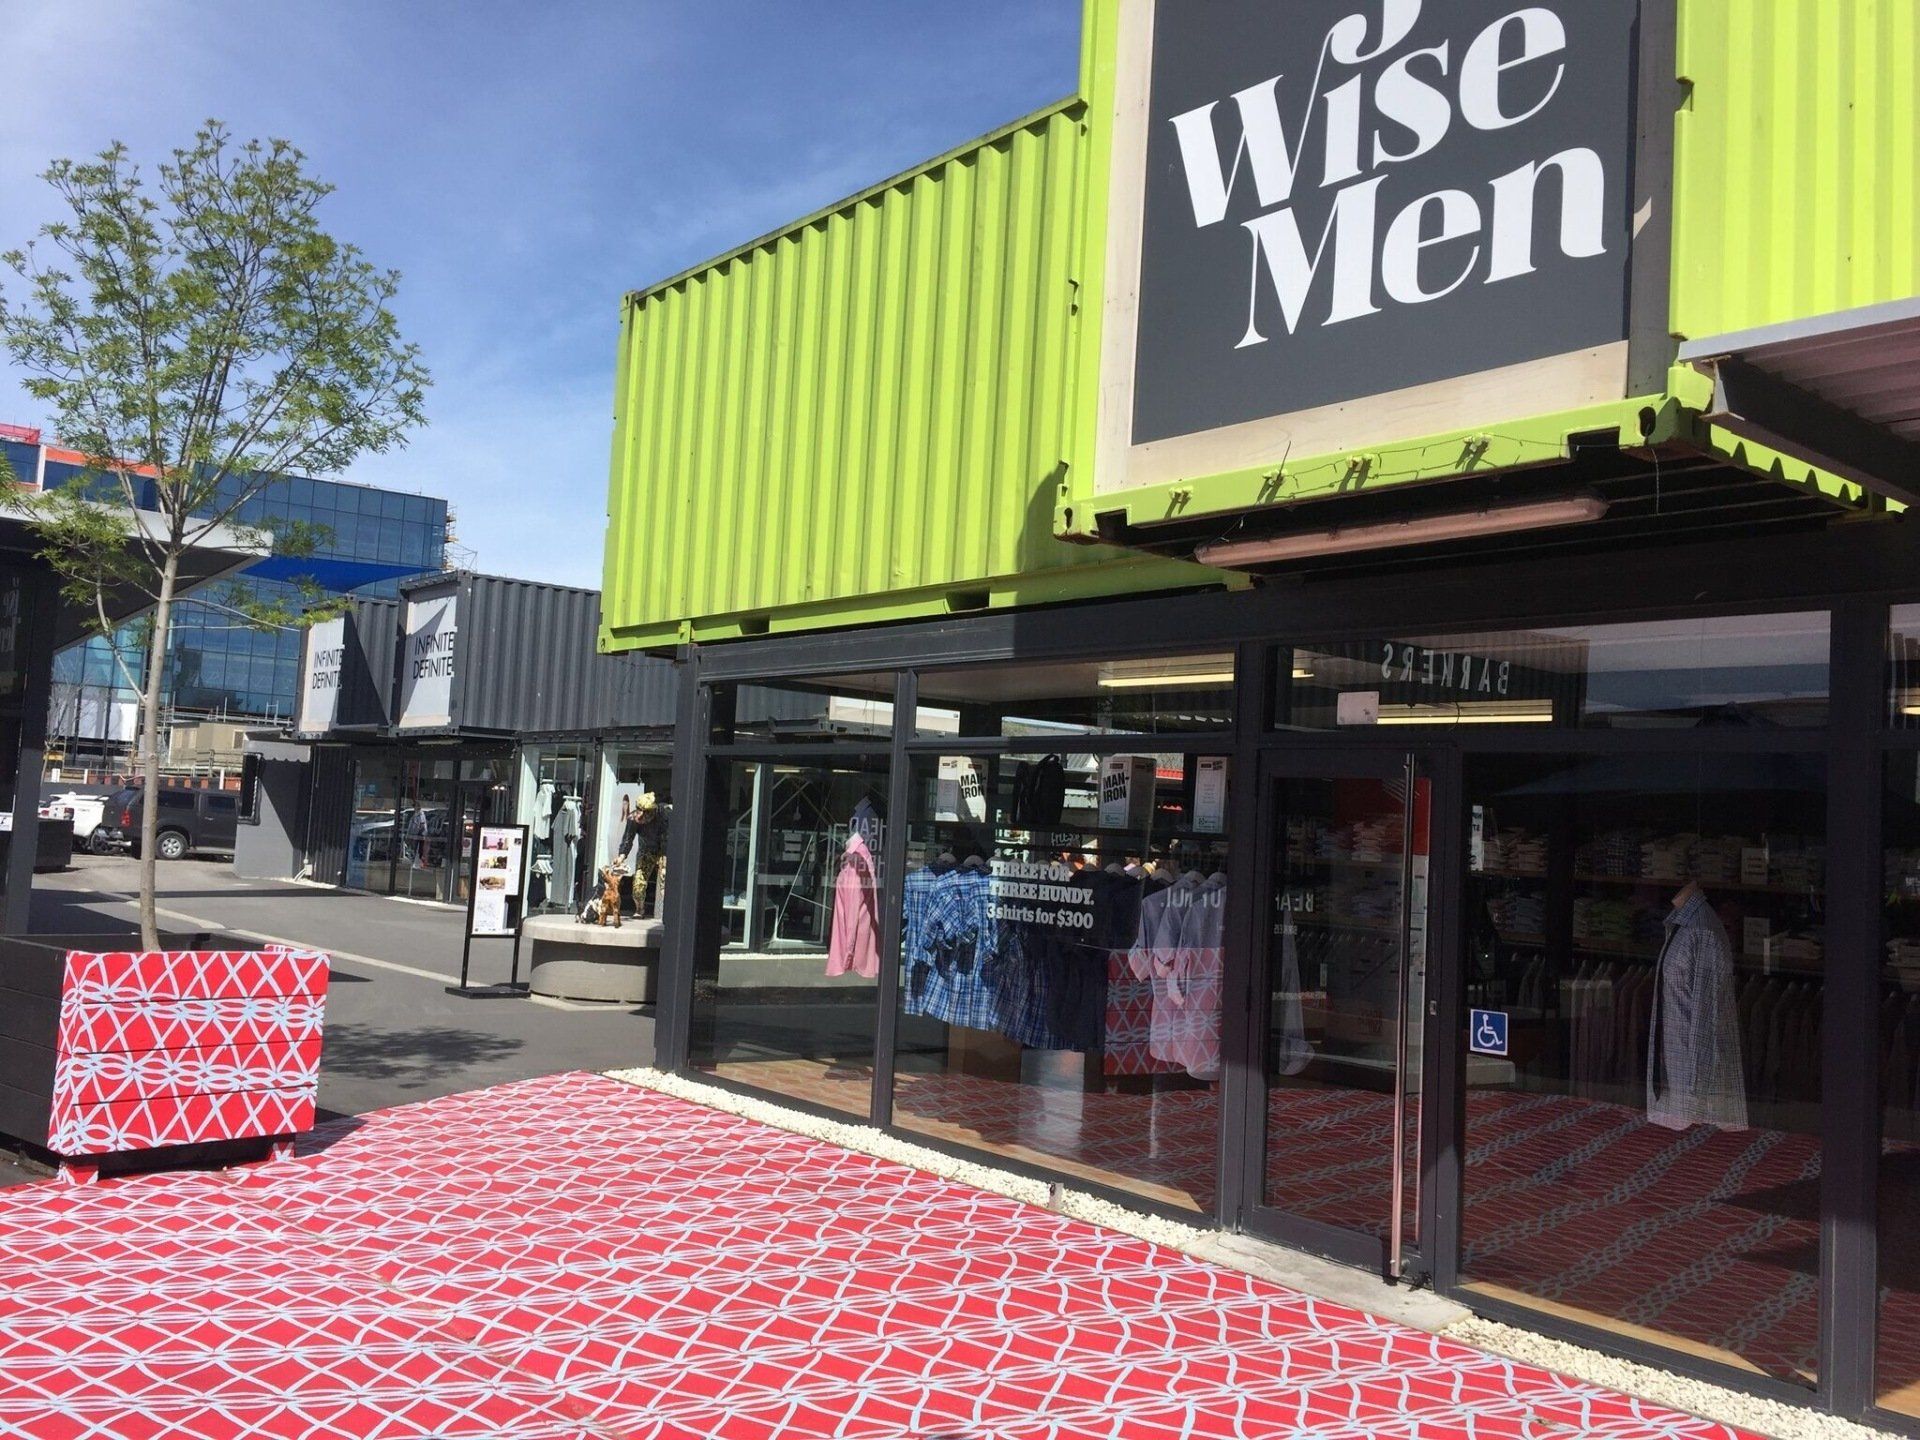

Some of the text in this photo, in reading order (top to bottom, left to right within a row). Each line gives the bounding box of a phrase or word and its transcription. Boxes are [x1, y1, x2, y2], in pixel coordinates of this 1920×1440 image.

[1168, 6, 1567, 229] Wise
[1233, 146, 1608, 351] Men
[415, 631, 455, 656] INFINITE
[413, 656, 454, 680] DEFINITE
[961, 786, 985, 800] IRON
[1103, 772, 1130, 790] MAN-
[1103, 785, 1127, 804] IRON
[990, 861, 1071, 882] THREE FOR
[989, 880, 1095, 906] THREE HUNDY.
[987, 903, 1094, 930] 3 shirts for $300
